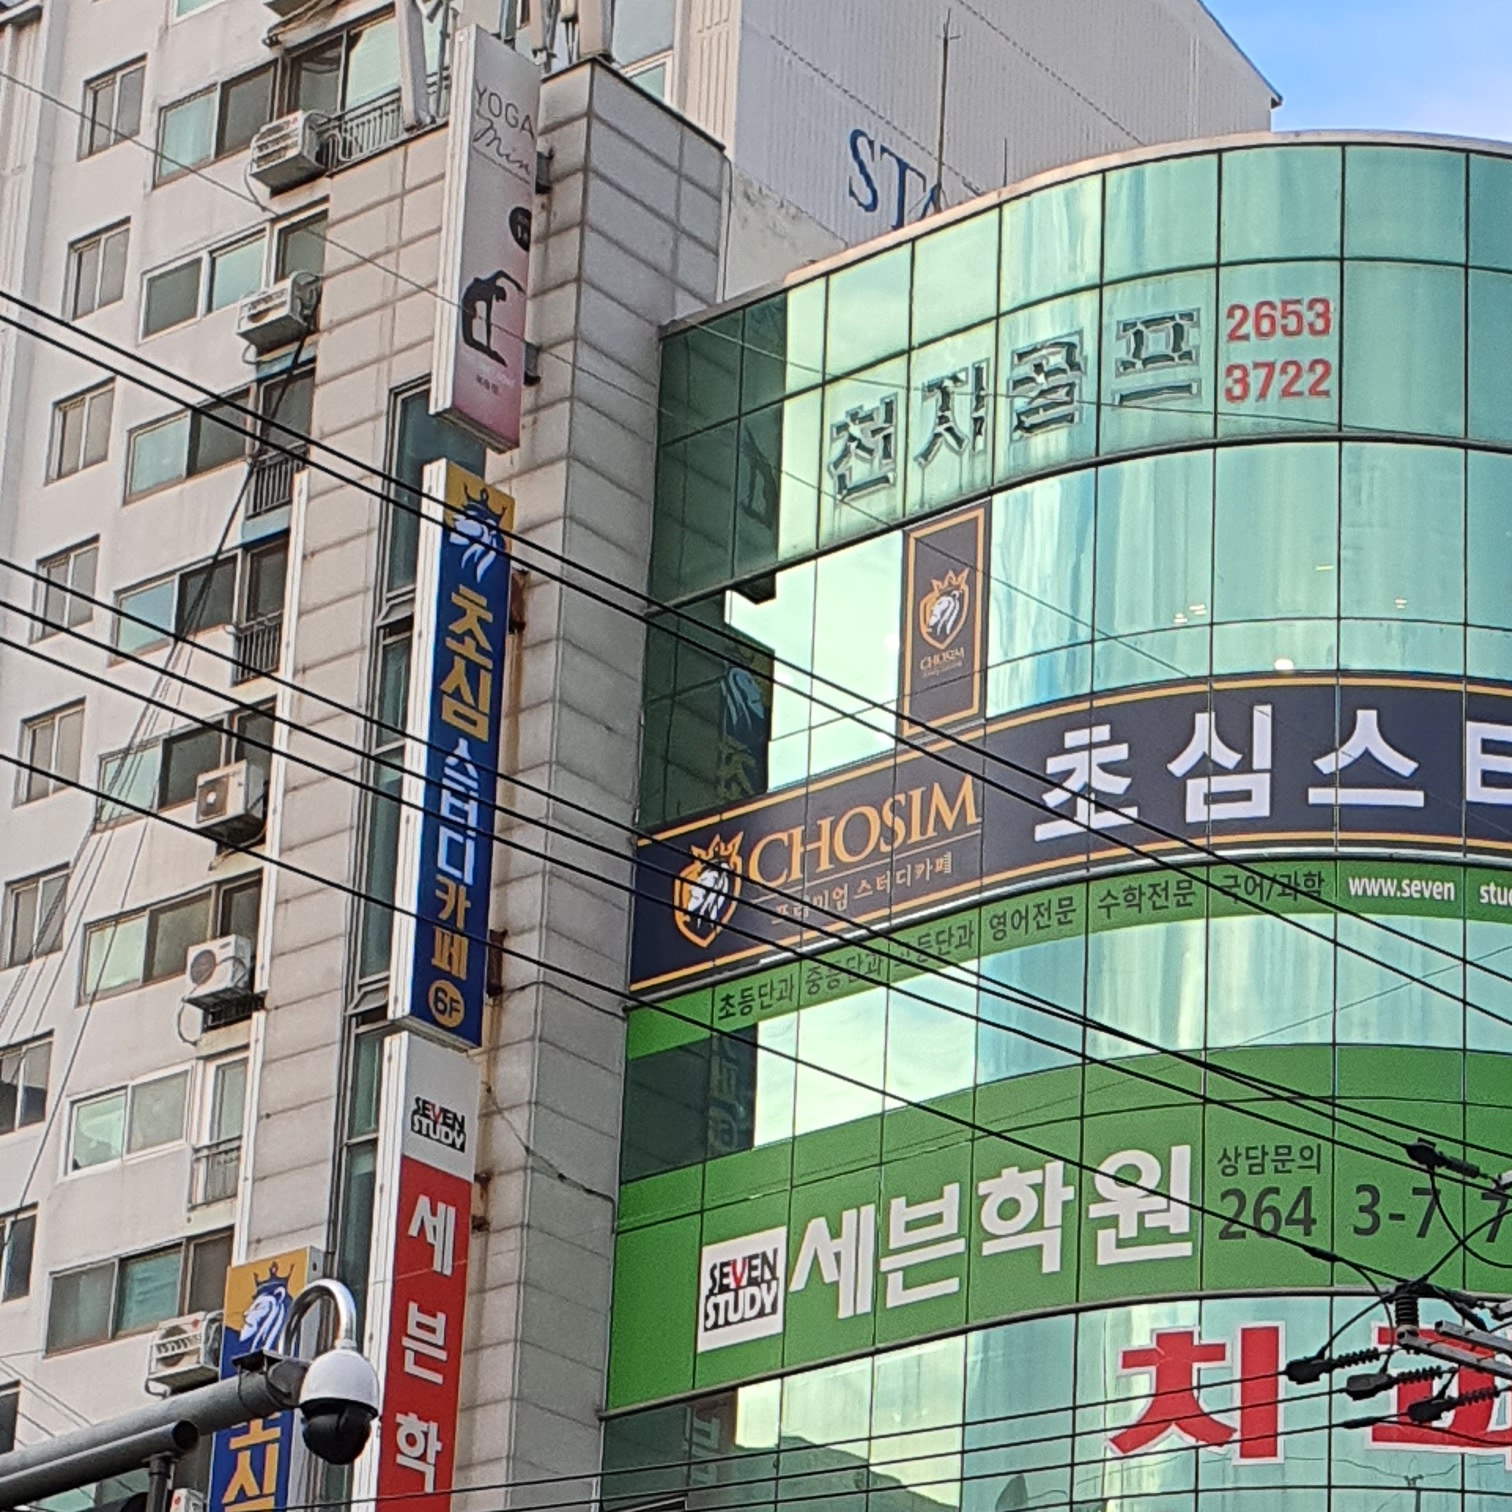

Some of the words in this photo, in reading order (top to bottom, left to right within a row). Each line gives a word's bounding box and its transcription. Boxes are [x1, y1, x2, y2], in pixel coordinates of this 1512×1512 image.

[474, 80, 535, 140] YOGA
[1225, 297, 1333, 342] 2653
[829, 307, 1200, 502] 천지골프
[1224, 358, 1333, 403] 3722
[749, 775, 981, 886] CHOSIM
[718, 974, 794, 1021] 초등단과
[989, 896, 1076, 941] 영어전문
[1097, 877, 1196, 920] 수학전문
[1348, 875, 1455, 903] www.seven
[411, 1113, 466, 1152] STUDY
[414, 1096, 466, 1131] SEVEN
[1217, 1144, 1323, 1178] 상담문의
[789, 1144, 1194, 1320] 세븐학원
[709, 1248, 778, 1296] SEVEN
[704, 1281, 778, 1331] STUDY
